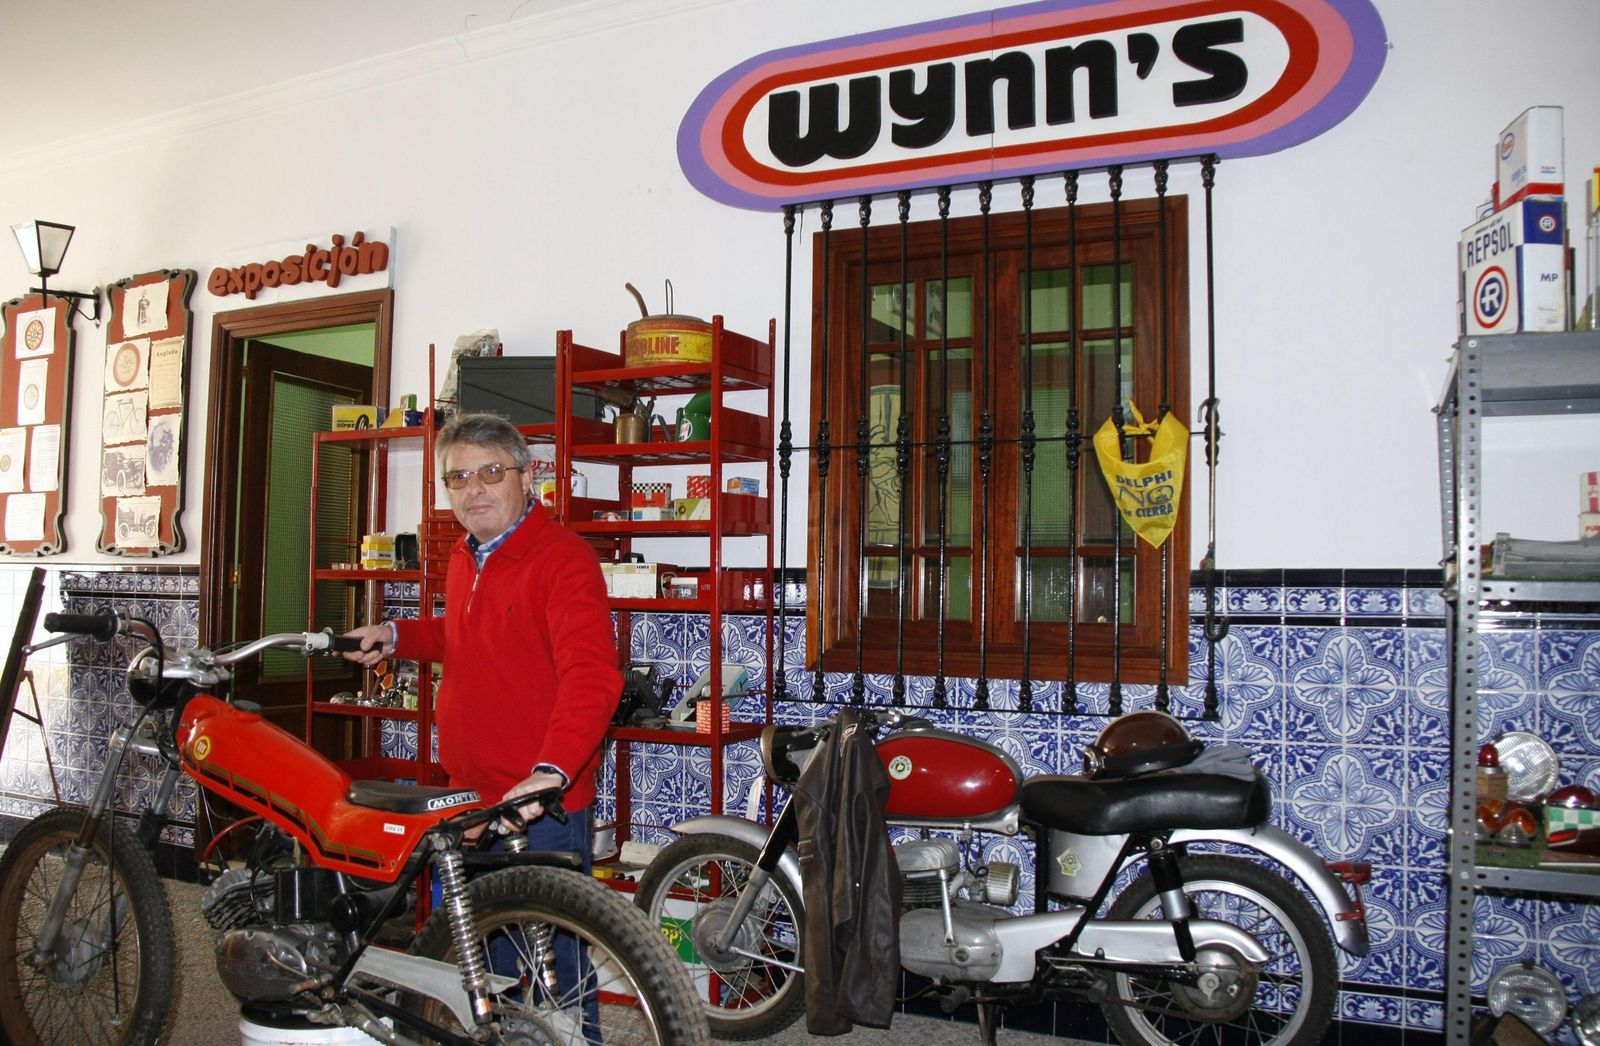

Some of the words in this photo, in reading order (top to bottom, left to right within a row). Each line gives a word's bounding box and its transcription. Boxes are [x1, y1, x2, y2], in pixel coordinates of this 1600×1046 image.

[1467, 221, 1514, 268] REPSOL
[1541, 272, 1559, 282] MP
[1116, 470, 1172, 488] DELPHI
[1136, 503, 1173, 518] CIERRA
[433, 792, 480, 808] MONTE
